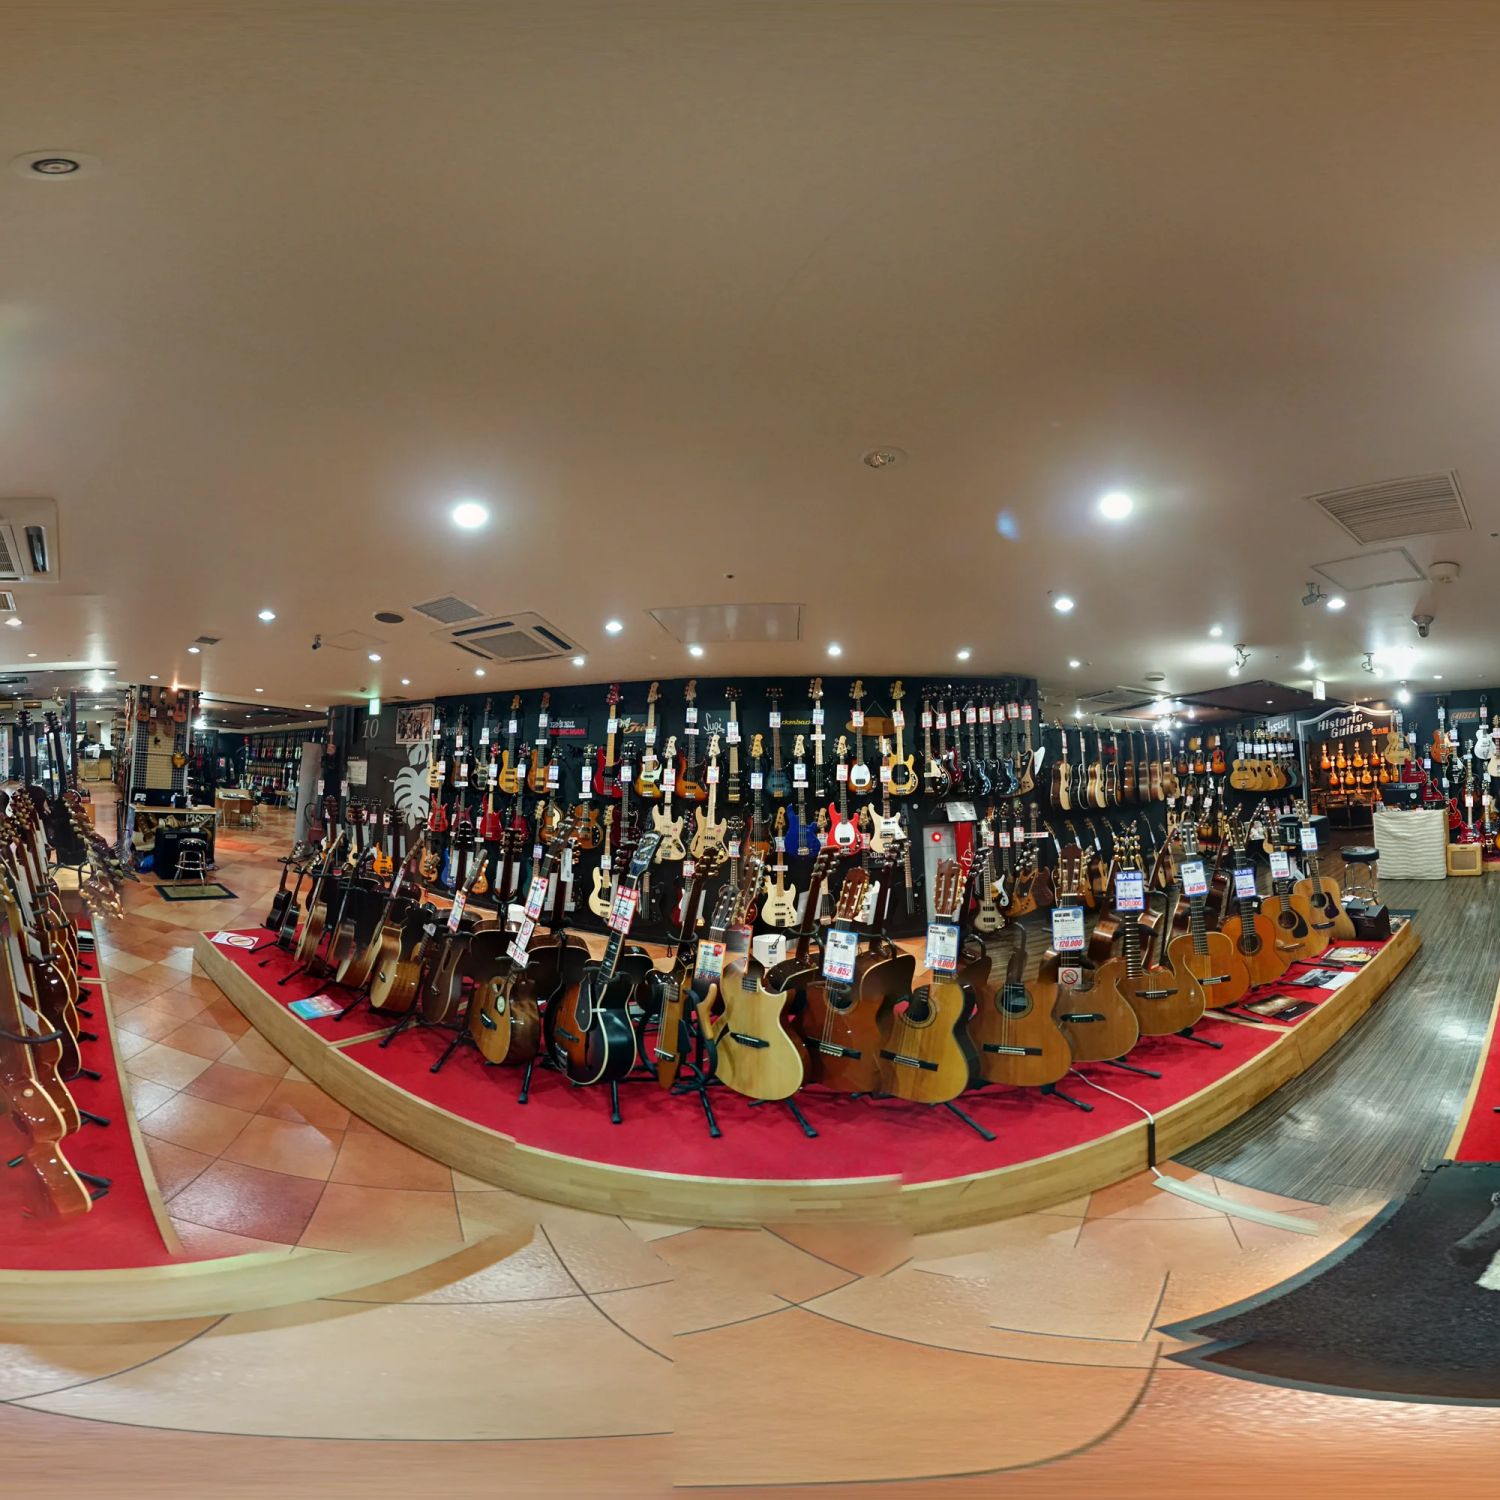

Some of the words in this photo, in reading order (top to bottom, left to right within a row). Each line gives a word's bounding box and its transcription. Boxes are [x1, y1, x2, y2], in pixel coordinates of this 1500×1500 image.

[362, 718, 379, 738] 10
[1317, 713, 1363, 731] Historic
[1330, 720, 1374, 738] Guitars
